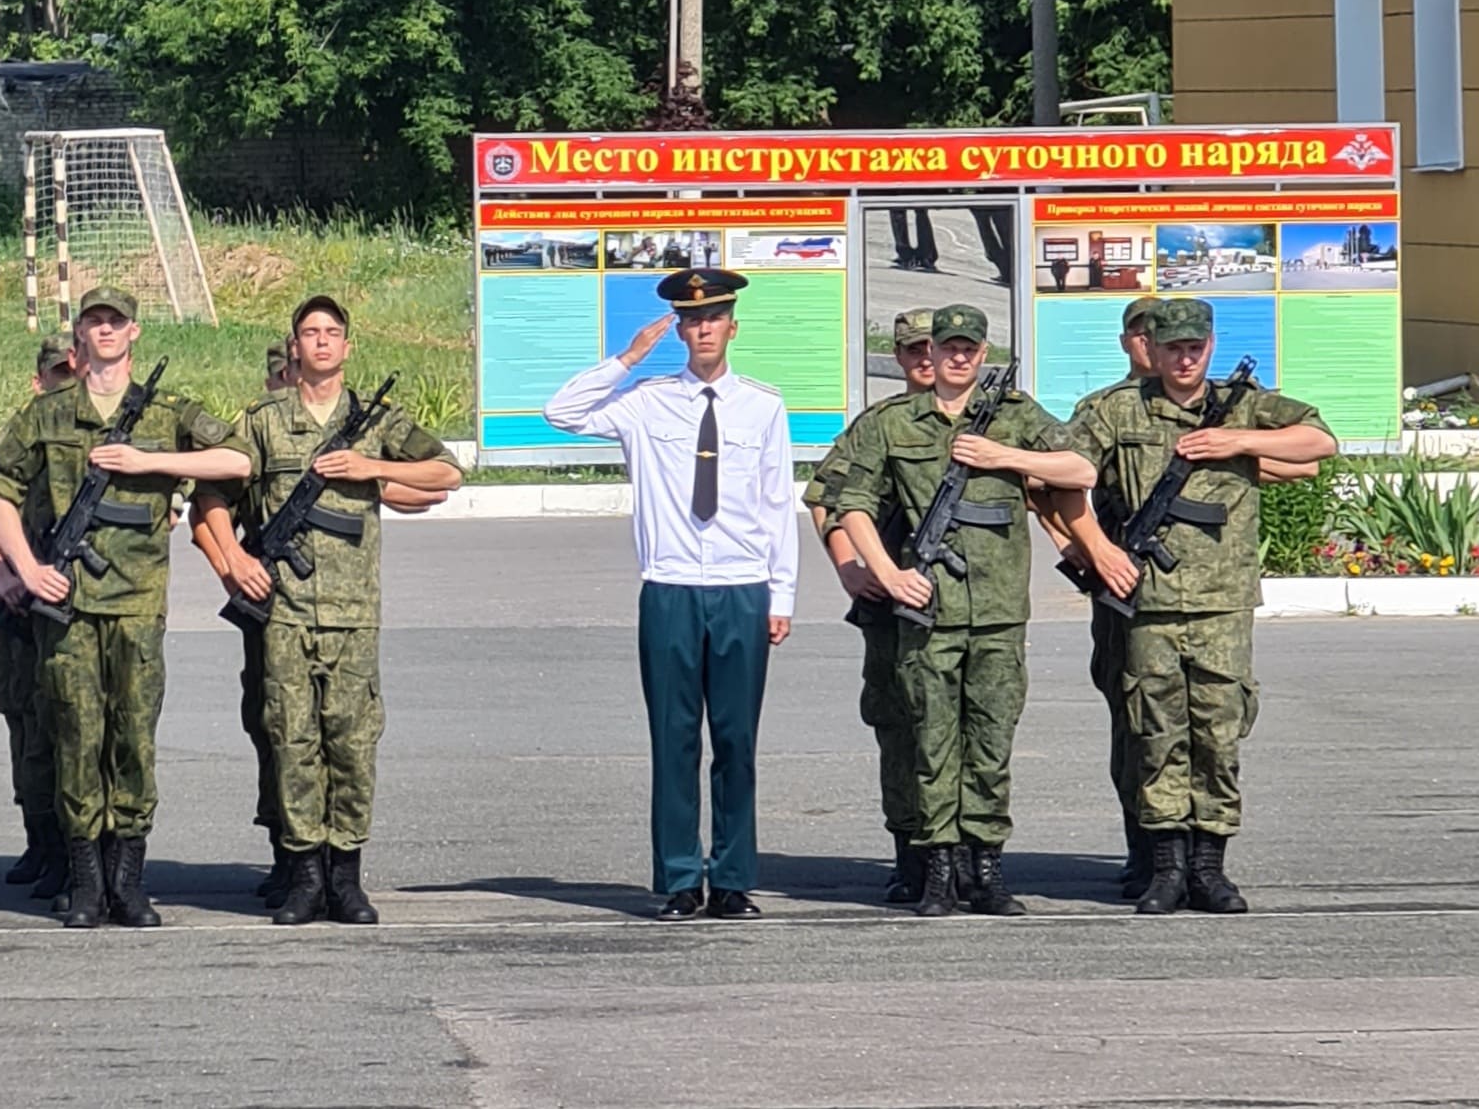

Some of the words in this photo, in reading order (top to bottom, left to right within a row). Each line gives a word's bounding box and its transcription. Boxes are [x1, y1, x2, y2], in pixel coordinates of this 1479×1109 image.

[528, 140, 659, 173] Место
[672, 145, 948, 182] инструктажа
[960, 142, 1166, 180] суточного
[1181, 139, 1328, 175] наряда
[493, 208, 551, 220] Действия
[553, 209, 577, 219] лиц
[579, 208, 640, 221] суточного
[642, 208, 684, 220] наряда
[687, 208, 695, 217] в
[698, 207, 766, 217] нештатных
[769, 207, 833, 218] ситуациях
